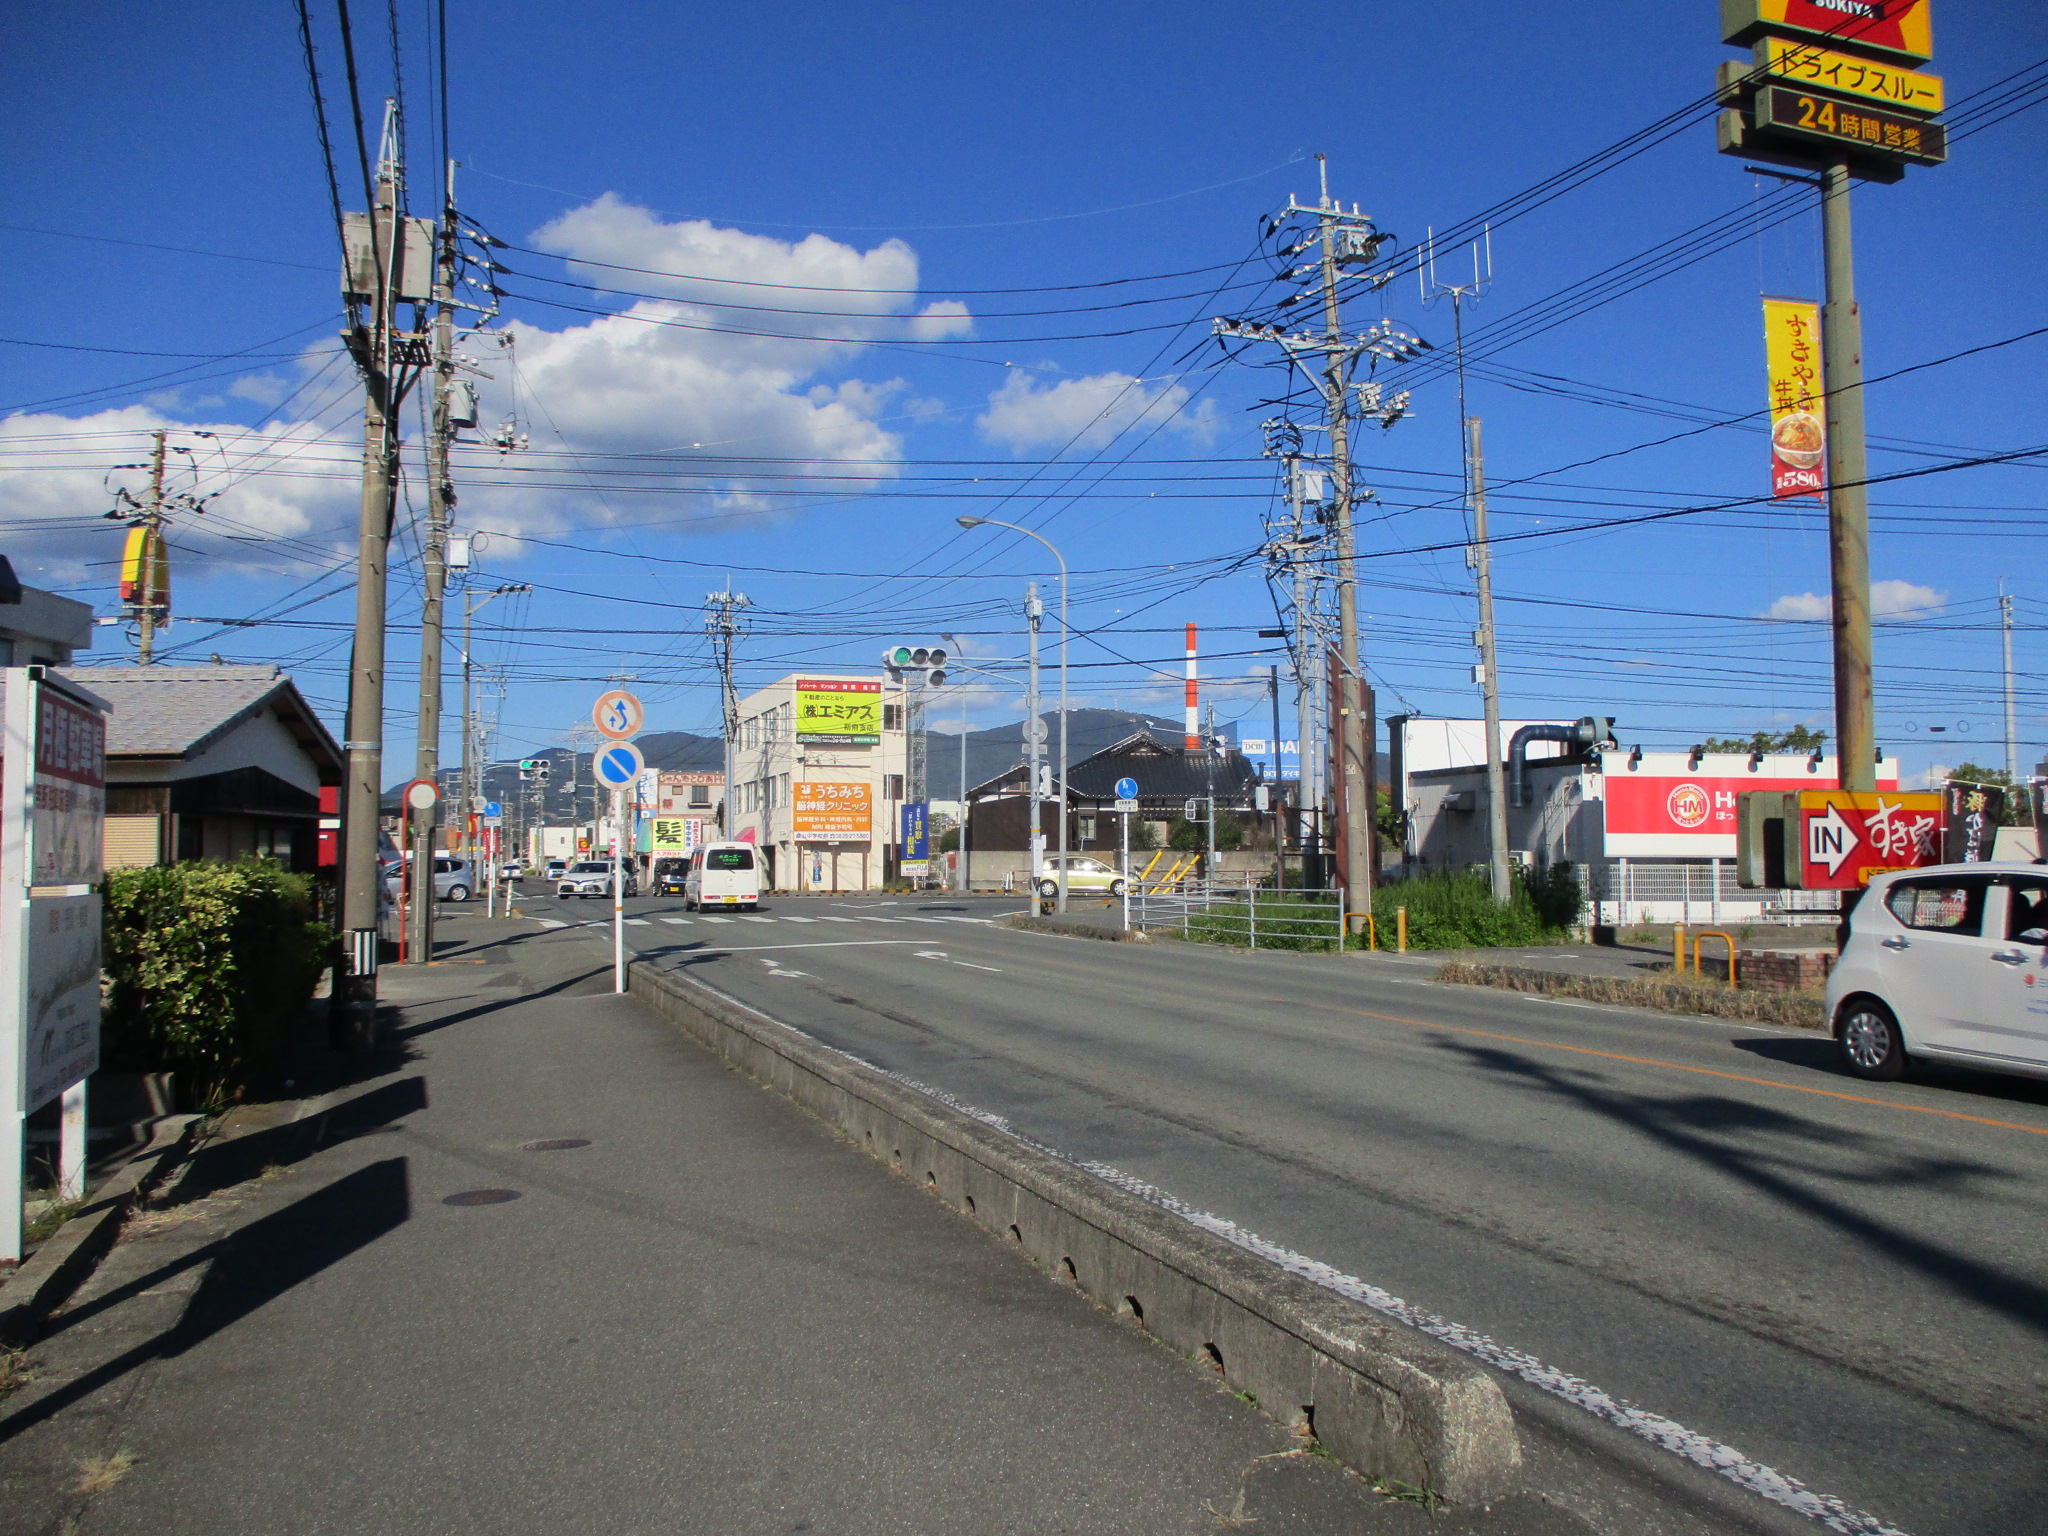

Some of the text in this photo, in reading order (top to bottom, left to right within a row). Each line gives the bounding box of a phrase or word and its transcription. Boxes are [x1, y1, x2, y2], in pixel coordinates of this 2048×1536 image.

[1814, 0, 1875, 19] SUKIYA
[1781, 47, 1936, 101] ドライブスルー
[1797, 96, 1922, 151] 24時間営業
[41, 699, 104, 781] 月極駐車場
[815, 784, 865, 799] うちみち
[1715, 791, 1736, 808] H
[796, 800, 868, 812] 脳神経クリニック
[1674, 799, 1704, 814] HM
[655, 821, 682, 844] 髪
[1813, 825, 1843, 855] IN
[1864, 796, 1936, 866] すき家
